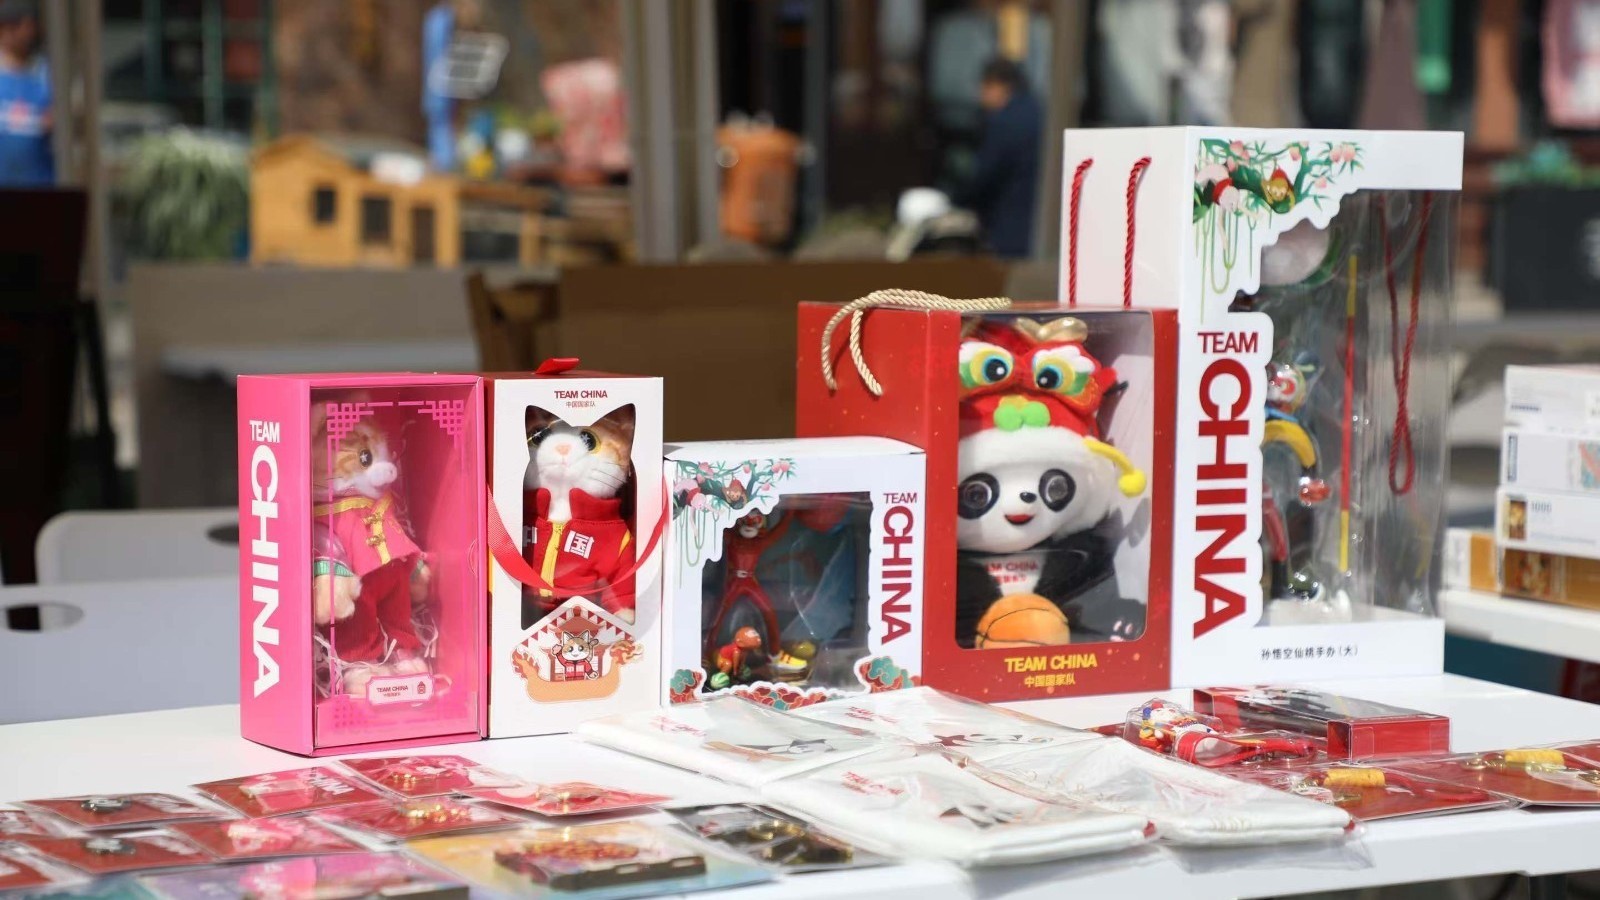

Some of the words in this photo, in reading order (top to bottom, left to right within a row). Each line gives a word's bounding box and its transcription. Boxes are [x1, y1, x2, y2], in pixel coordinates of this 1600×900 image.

[1197, 332, 1258, 353] TEAM
[554, 390, 579, 399] TEAM
[580, 390, 608, 399] CHINA
[249, 420, 280, 442] TEAM
[883, 492, 917, 504] TEAM
[1193, 358, 1252, 640] CHINA
[563, 529, 595, 560] 国
[251, 444, 280, 698] CHINA
[881, 505, 914, 645] CHINA
[1004, 656, 1047, 673] TEAM
[1050, 653, 1098, 670] CHINA
[1024, 673, 1076, 688] 中国国家队
